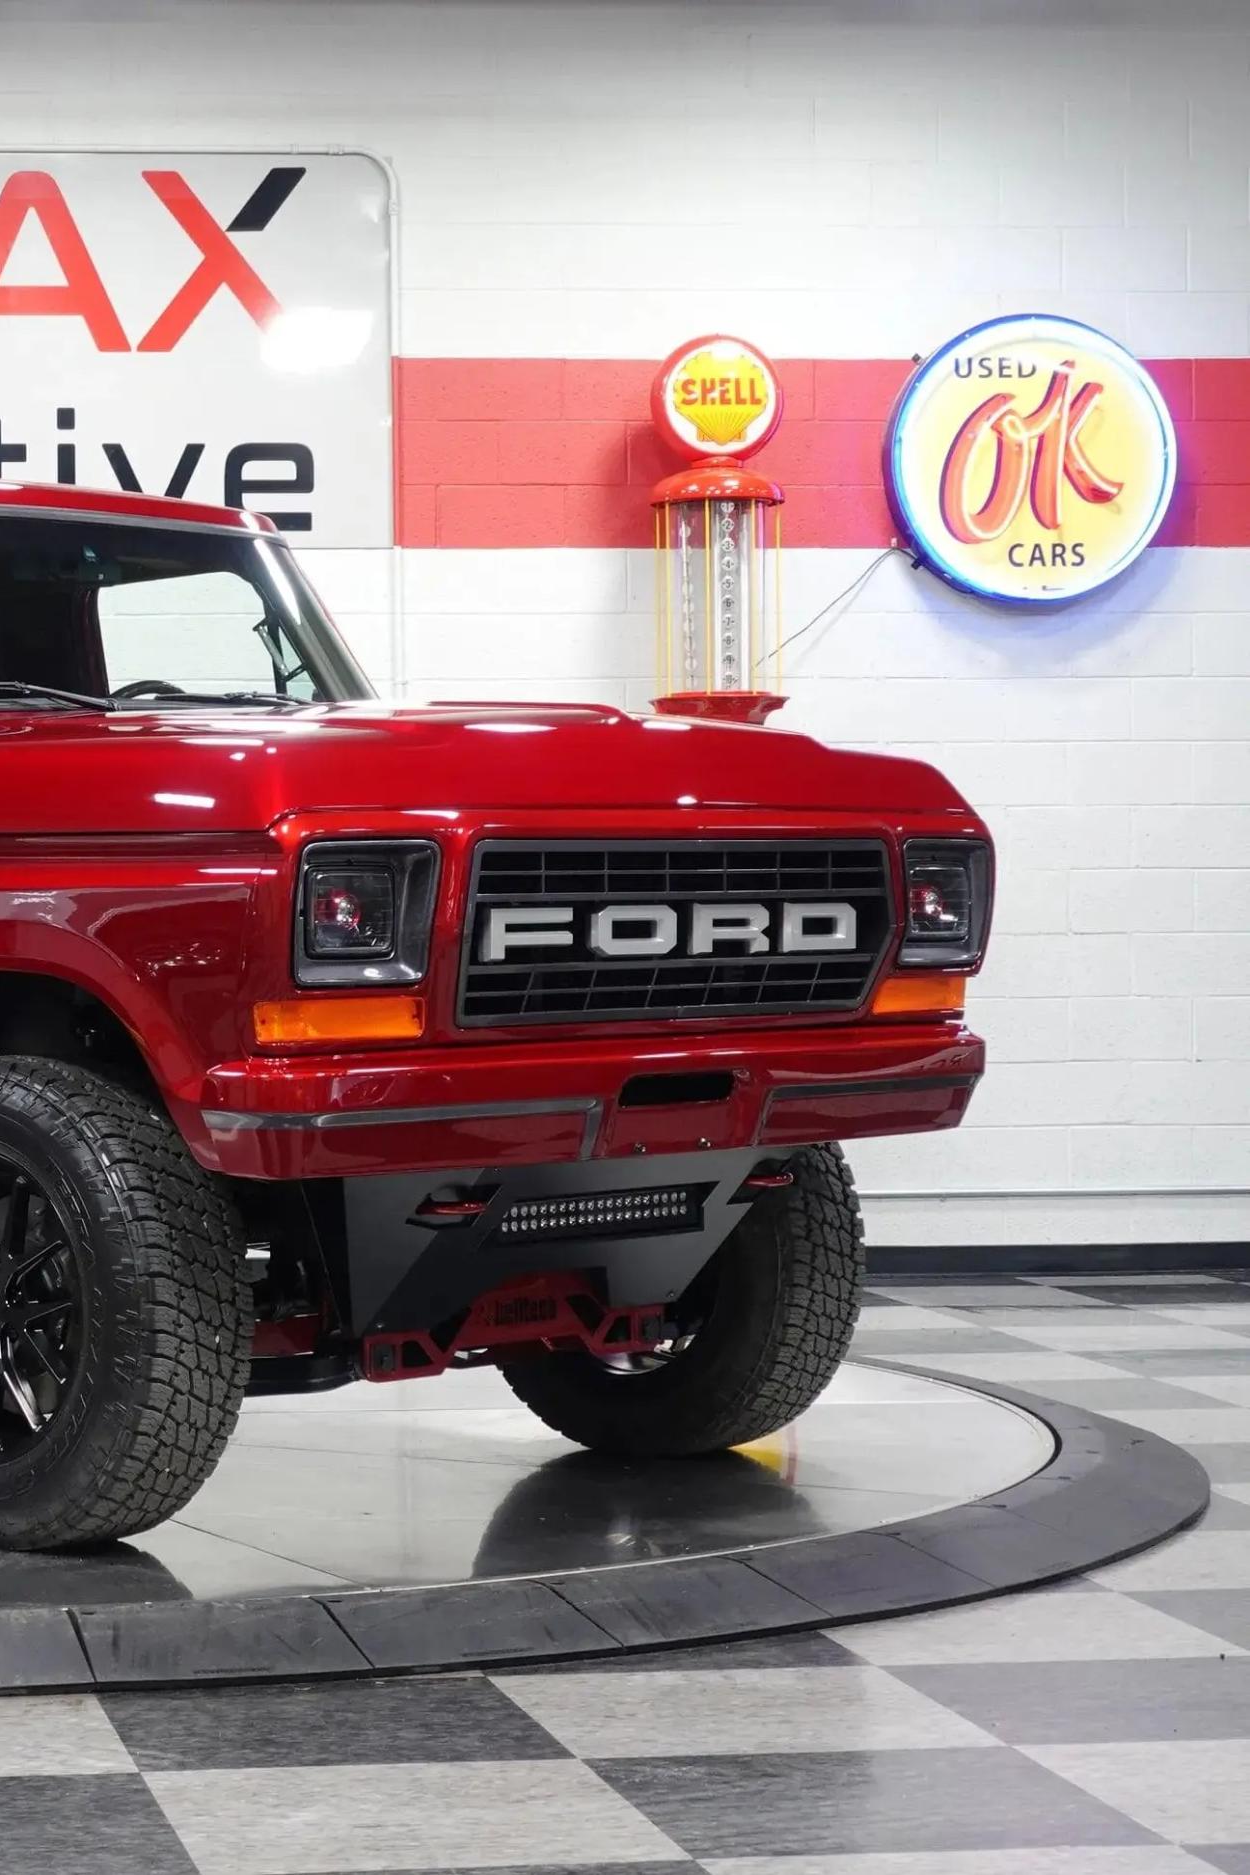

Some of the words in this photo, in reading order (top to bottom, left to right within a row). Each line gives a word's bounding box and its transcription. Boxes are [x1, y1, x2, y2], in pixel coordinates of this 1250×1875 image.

[953, 356, 1037, 379] USED
[681, 377, 762, 406] SHELL
[939, 360, 1124, 544] OK
[725, 520, 731, 530] 2
[725, 540, 731, 550] 3
[1008, 542, 1085, 568] CARS
[725, 559, 731, 569] 4
[725, 578, 731, 588] 5
[479, 903, 857, 963] FORD
